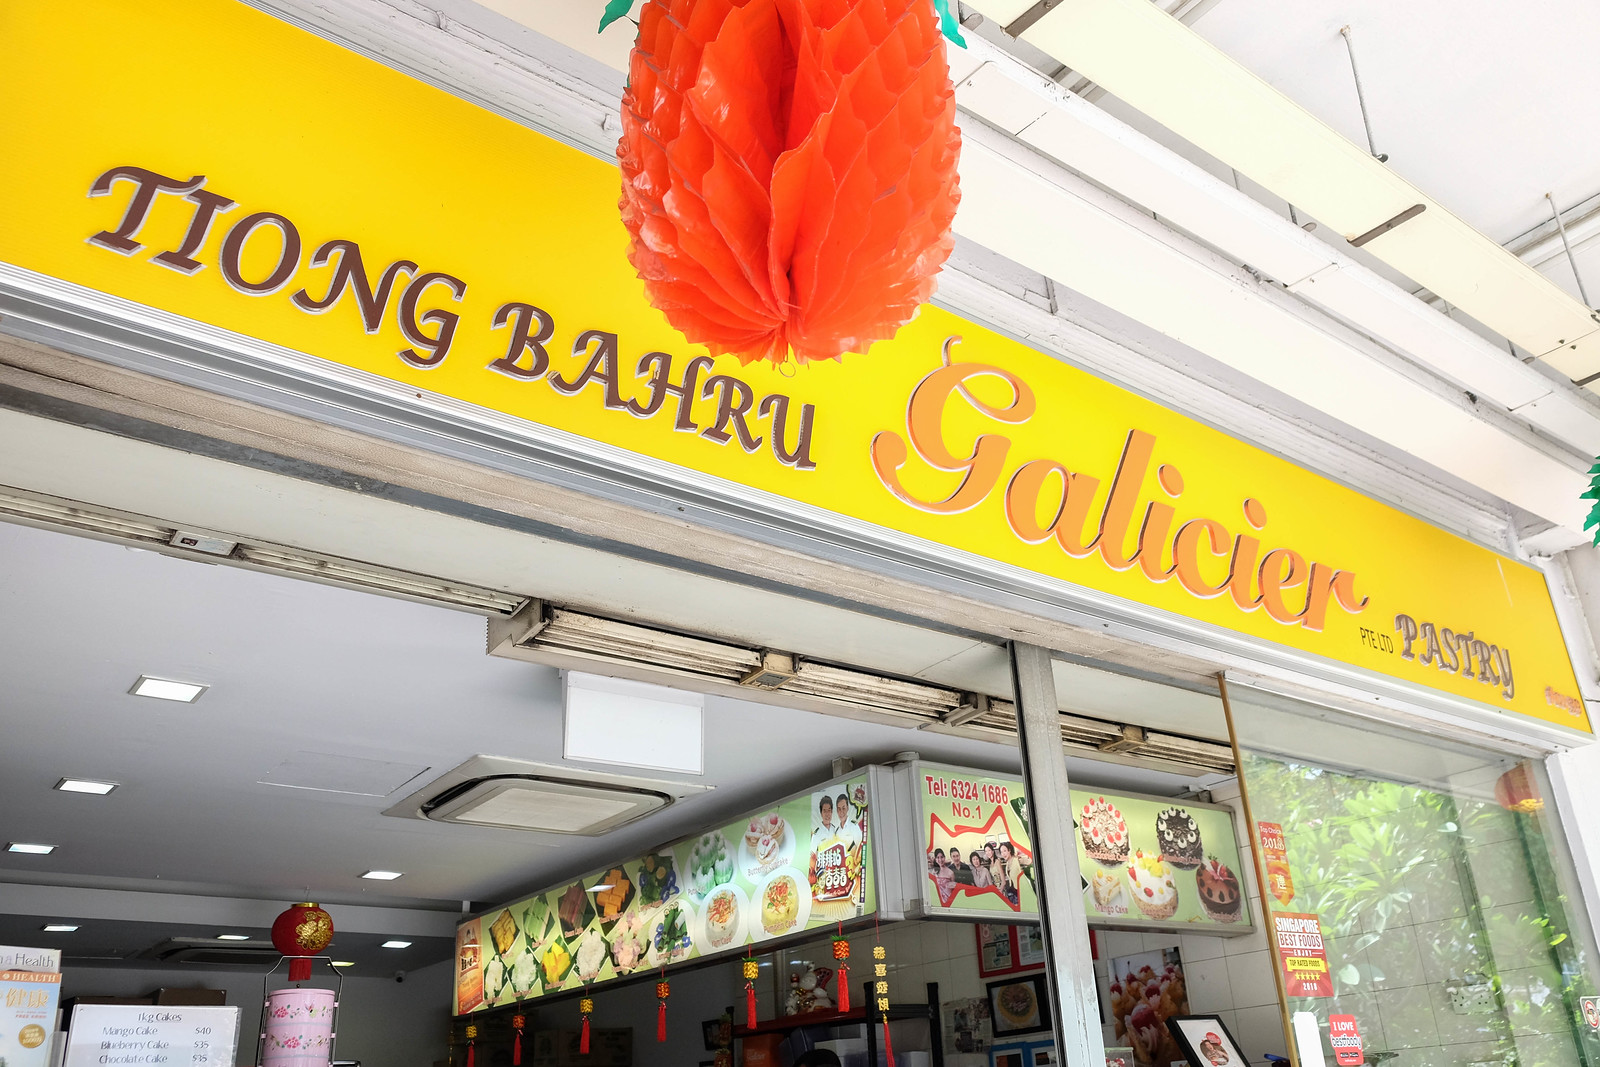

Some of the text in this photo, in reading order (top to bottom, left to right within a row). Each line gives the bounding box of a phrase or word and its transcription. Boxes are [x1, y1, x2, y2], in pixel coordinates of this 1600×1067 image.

[84, 166, 816, 471] TIONG BAHRU
[870, 335, 1370, 632] Galicier
[1359, 627, 1394, 654] PTE LTD
[1394, 613, 1515, 701] PASTRY
[925, 776, 1009, 805] Tel: 6324 1686
[952, 802, 982, 819] No.1
[1275, 917, 1320, 933] SINGAPORE
[1279, 933, 1321, 947] BEST FOODS
[15, 953, 54, 967] Health
[12, 972, 57, 983] HEALTH
[6, 987, 49, 1009] 健康
[155, 1012, 182, 1022] Cakes
[102, 1026, 158, 1037] Mango Cake
[195, 1026, 212, 1035] $40
[1332, 1021, 1354, 1031] I LOVE
[100, 1040, 169, 1051] Blueberry Cake
[194, 1040, 209, 1049] $35
[98, 1054, 168, 1064] Chocolate Cake
[192, 1054, 208, 1063] $35
